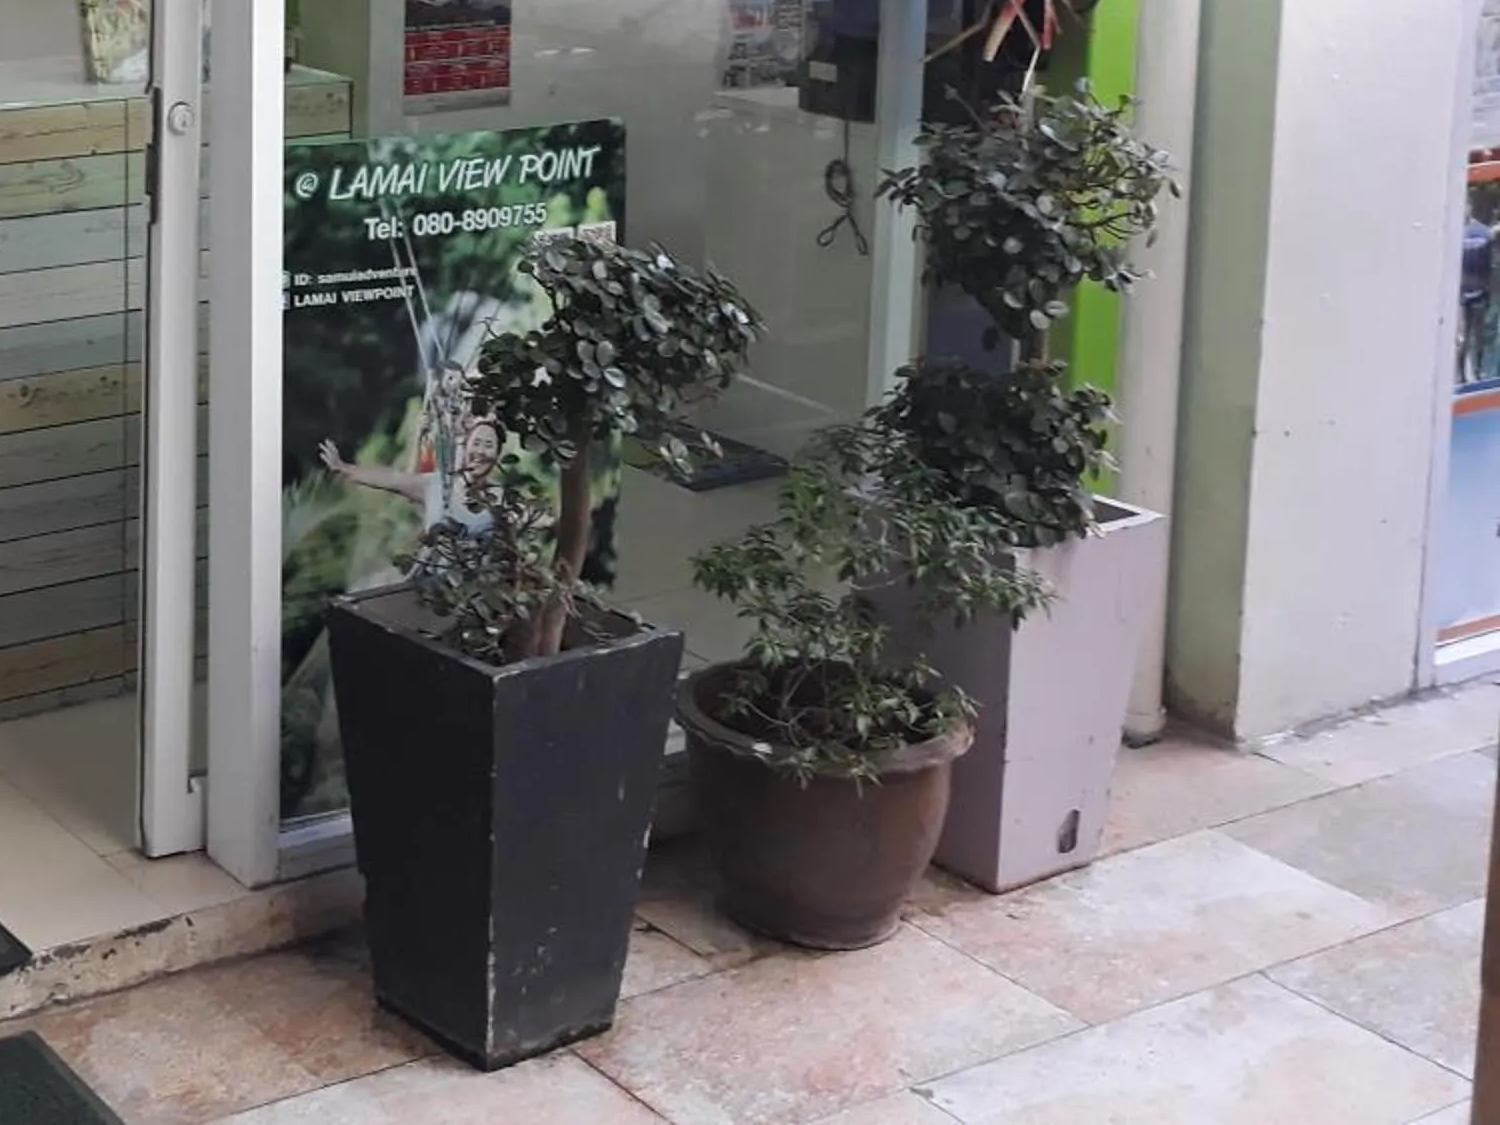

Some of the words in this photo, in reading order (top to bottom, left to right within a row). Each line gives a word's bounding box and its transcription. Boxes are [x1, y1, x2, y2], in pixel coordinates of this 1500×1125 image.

[329, 162, 428, 201] LAMAI
[437, 154, 511, 192] VIEW
[518, 145, 601, 184] POINT
[363, 217, 404, 241] Tel:
[413, 202, 549, 237] 080-8909755
[293, 291, 337, 308] LAMAI
[341, 285, 415, 304] VIEWPOINT
